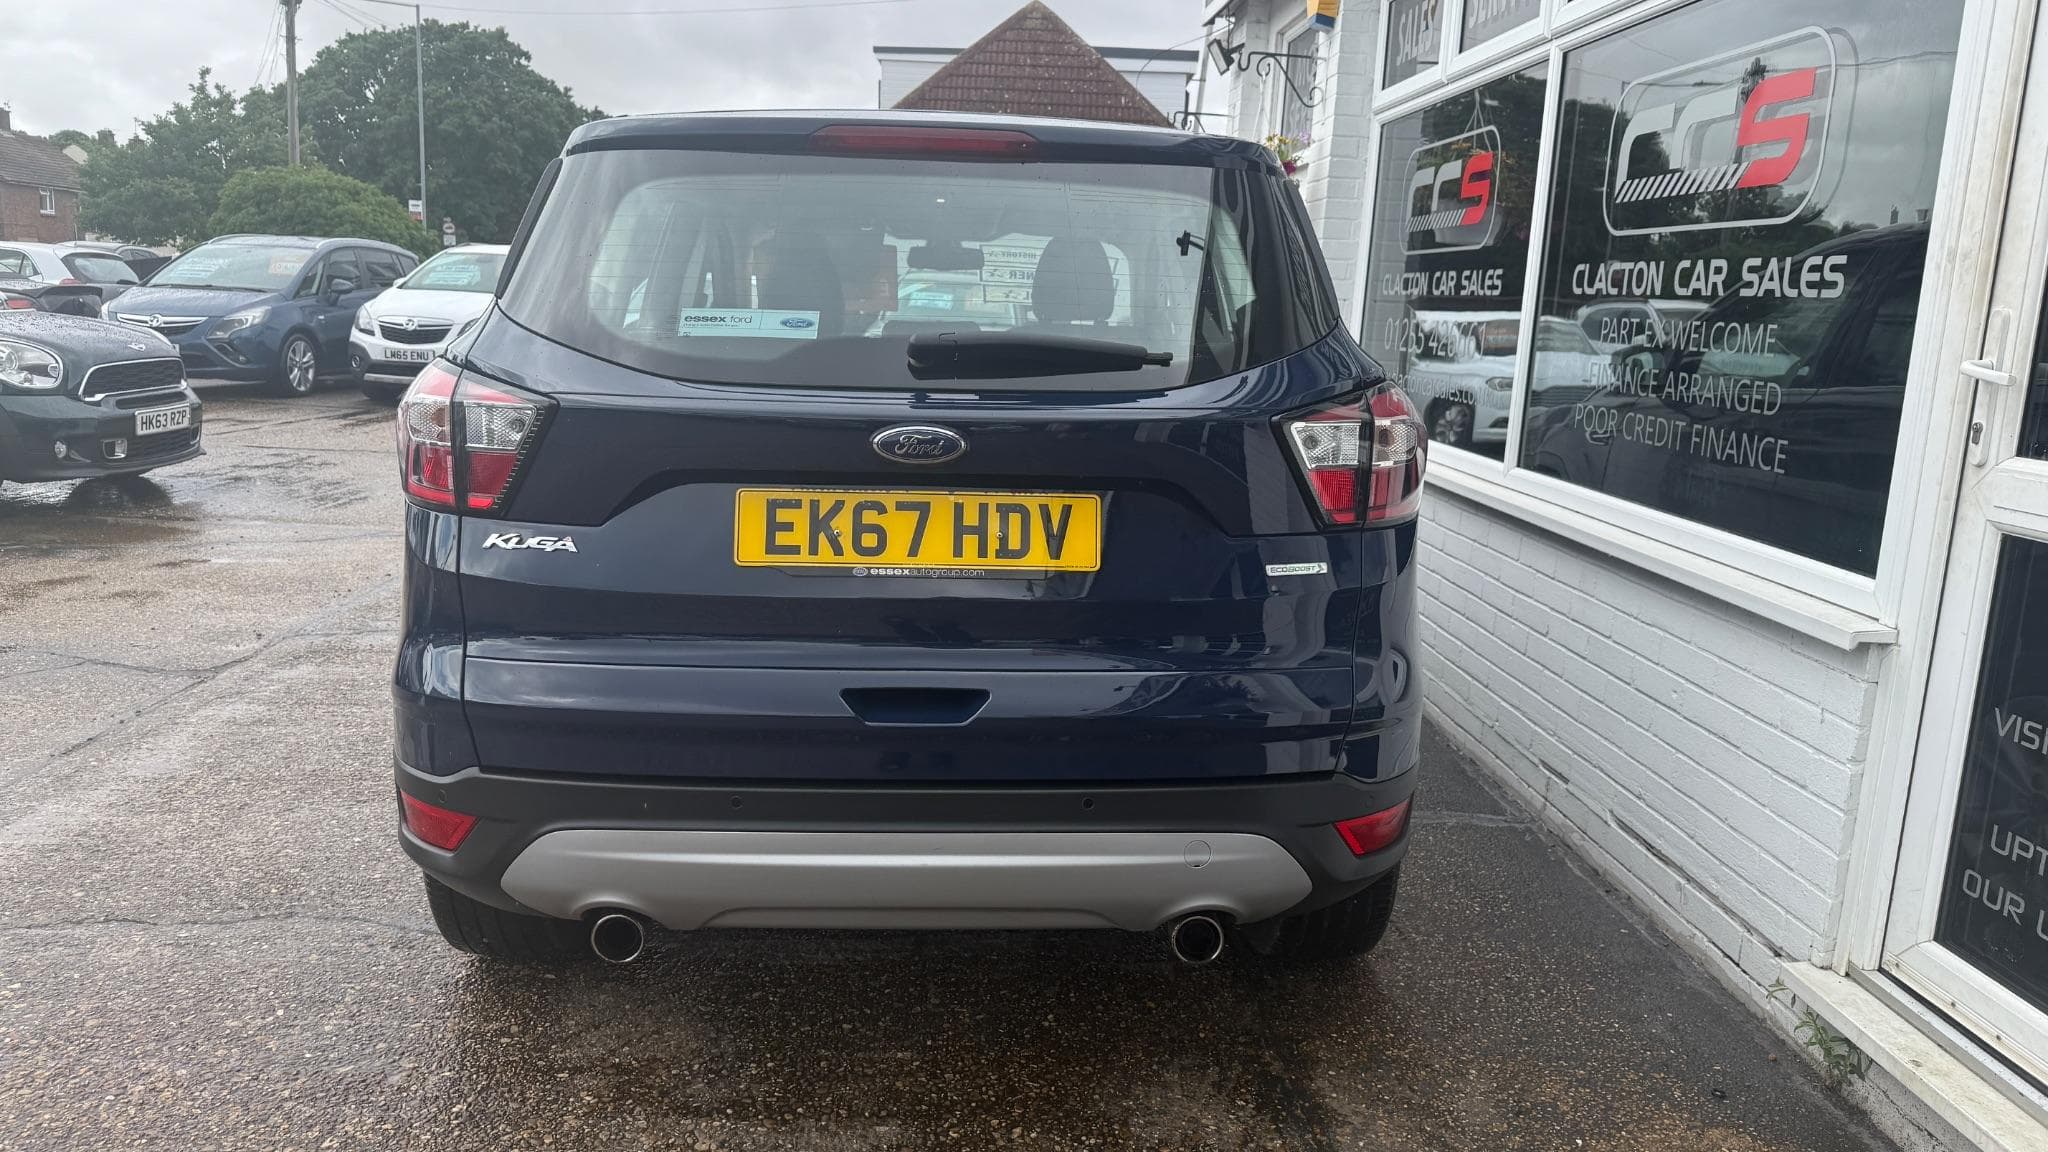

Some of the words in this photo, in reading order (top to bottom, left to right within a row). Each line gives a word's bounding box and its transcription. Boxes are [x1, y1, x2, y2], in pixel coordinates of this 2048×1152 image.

[1382, 271, 1430, 296] CLACTON
[1432, 269, 1457, 296] CAR
[1460, 268, 1504, 296] SALES
[1572, 260, 1664, 296] CLACTON
[1673, 258, 1728, 297] CAR
[1739, 255, 1848, 298] SALES
[684, 315, 727, 323] essex
[1601, 317, 1640, 345] PART
[1643, 319, 1665, 349] EX
[1671, 319, 1778, 358] WELCOME
[410, 351, 429, 361] ENU
[1588, 361, 1660, 398] FINANCE
[1662, 371, 1782, 416] ARRANGED
[140, 412, 168, 431] HK63
[170, 409, 187, 426] RZP
[894, 434, 945, 455] Ford
[1574, 403, 1618, 436] POOR
[1622, 411, 1687, 451] CREDIT
[1690, 424, 1789, 474] FINANCE
[482, 533, 578, 553] KUGA
[764, 498, 932, 558] EK67
[952, 501, 1073, 561] HDV
[869, 567, 985, 579] essexautogroup.com
[1962, 868, 2026, 926] OUR
